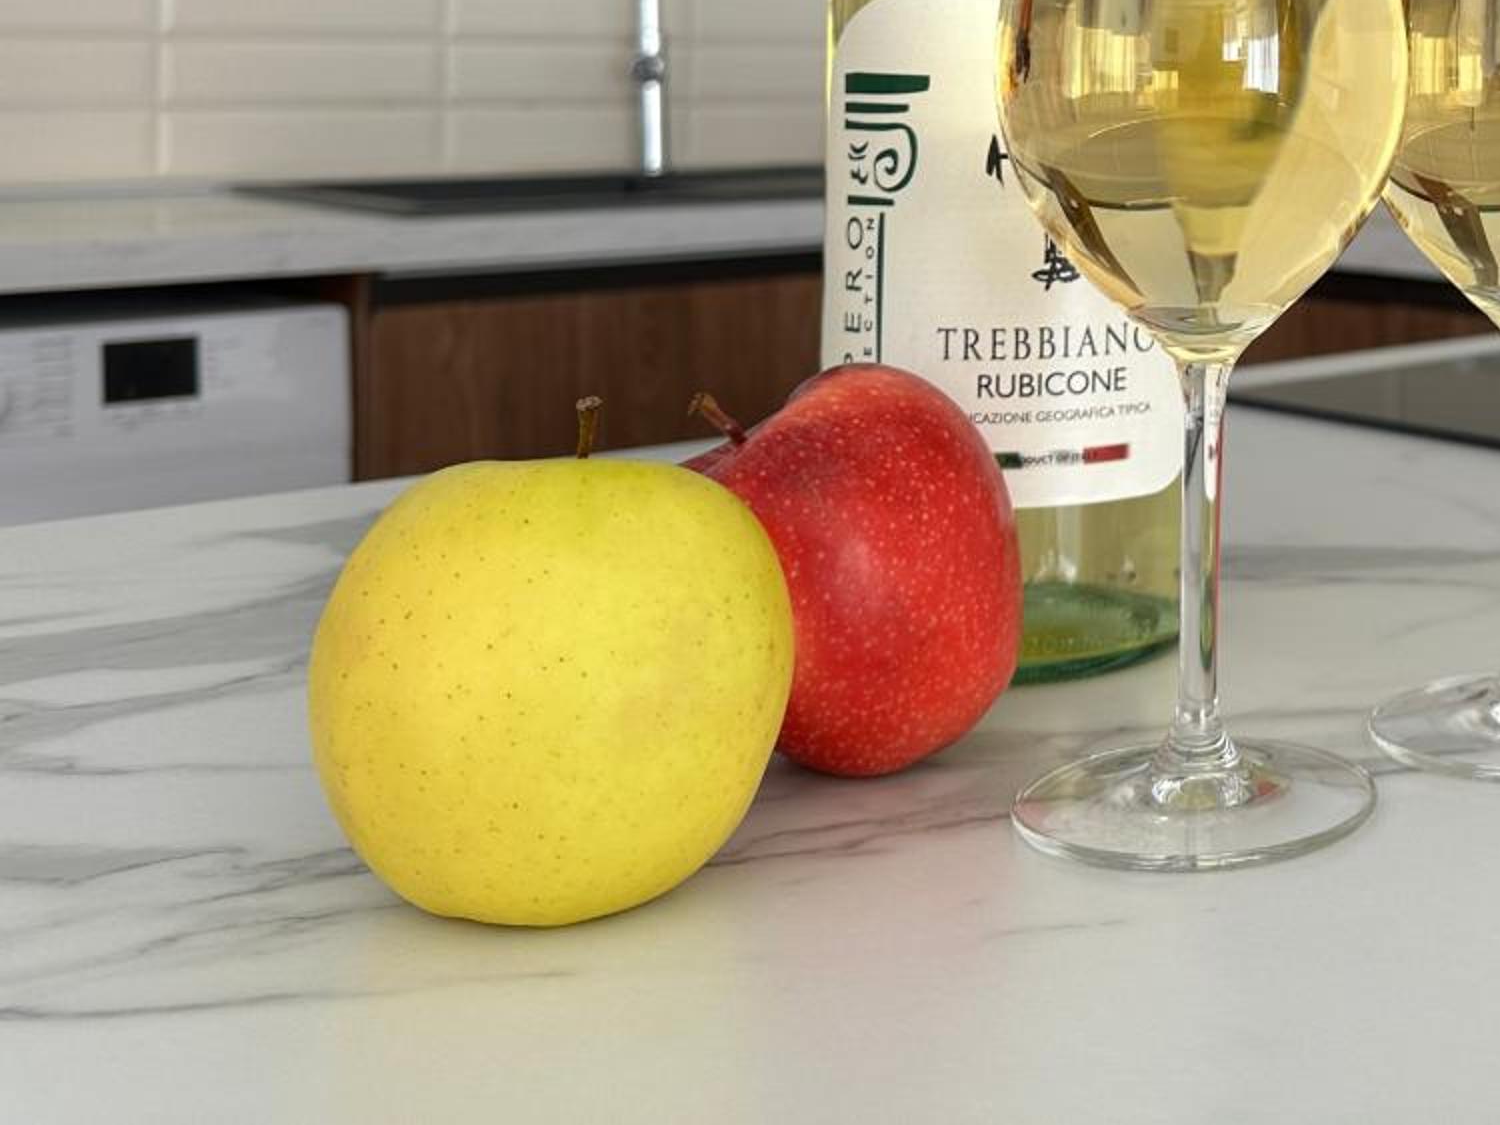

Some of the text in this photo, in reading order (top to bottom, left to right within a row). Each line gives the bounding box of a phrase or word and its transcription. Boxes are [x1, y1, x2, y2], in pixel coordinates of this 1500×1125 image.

[844, 216, 863, 363] PERO
[864, 218, 875, 356] ECTION
[969, 401, 1152, 424] ICAZIONE GEOGRAFICA TIPICA
[976, 367, 1127, 399] RUBICONE
